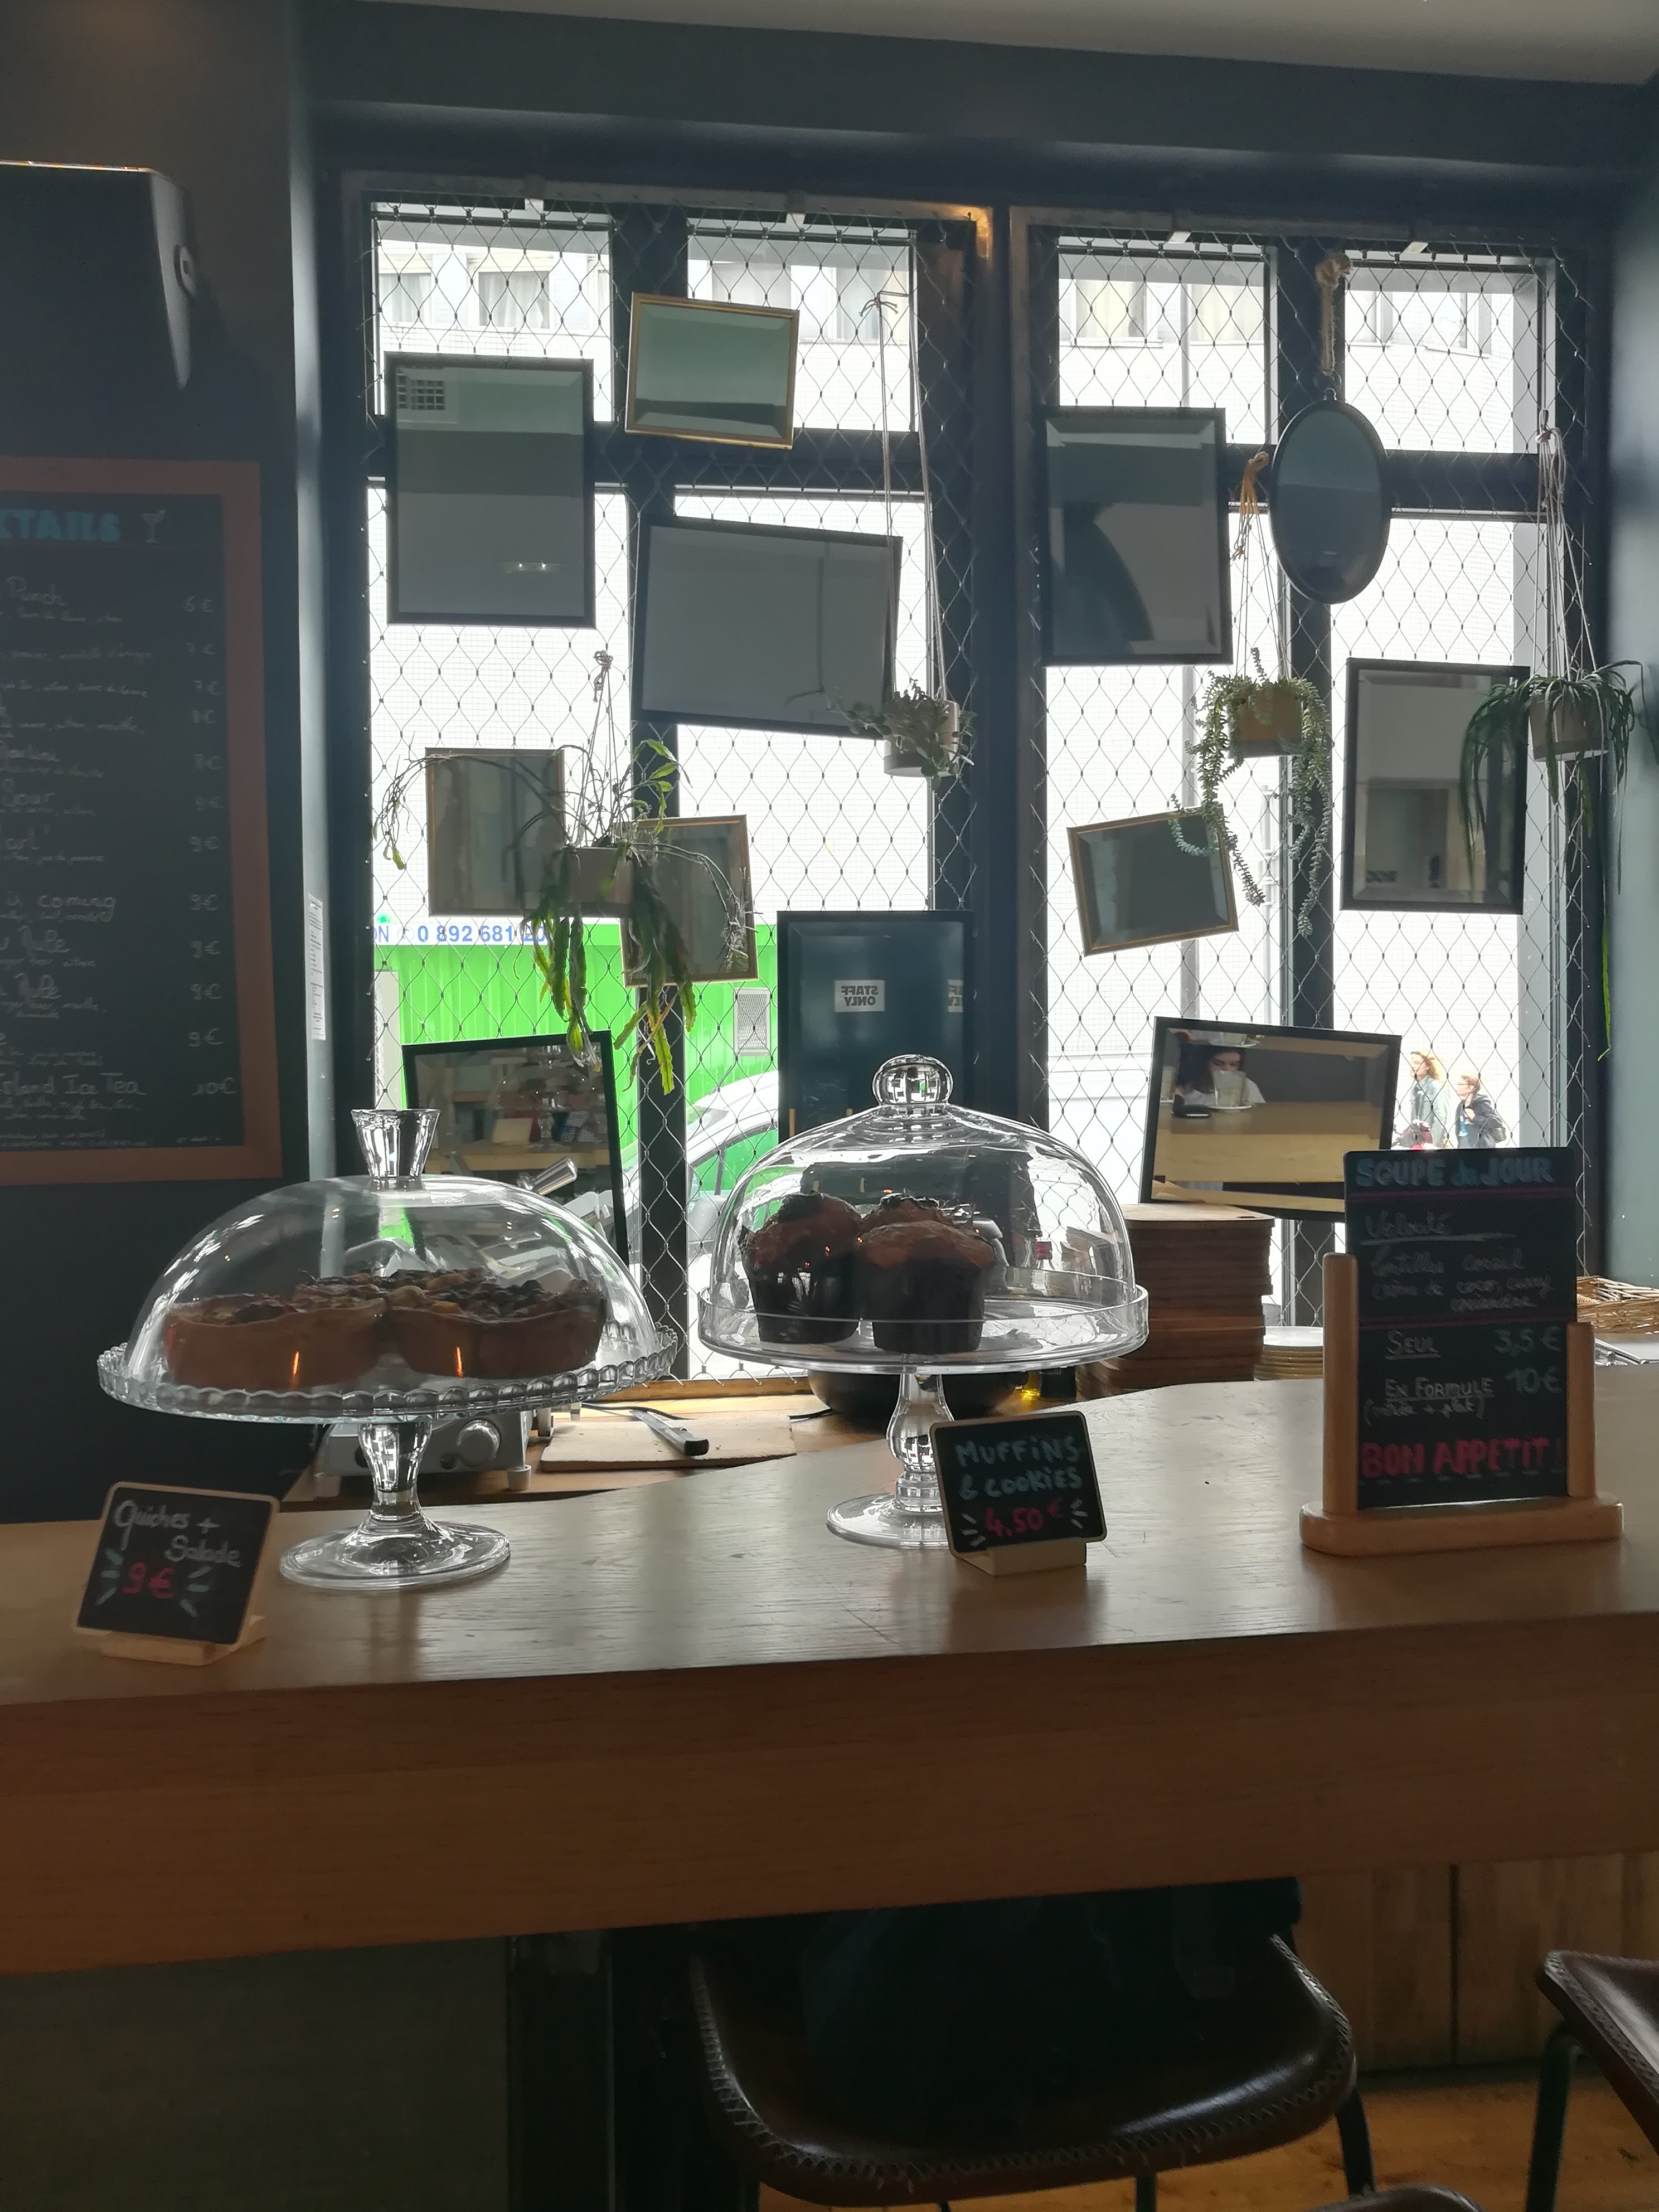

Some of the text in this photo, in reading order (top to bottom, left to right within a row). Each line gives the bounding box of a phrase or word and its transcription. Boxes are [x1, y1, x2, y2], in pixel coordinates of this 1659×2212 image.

[418, 925, 429, 942] 0
[436, 925, 473, 942] 892
[480, 925, 512, 942] 681
[188, 1027, 224, 1047] 9€
[99, 1072, 147, 1096] Tea
[191, 1076, 237, 1096] 10€
[1356, 1158, 1447, 1187] SOUPE
[1479, 1157, 1556, 1187] JOUR
[1361, 1442, 1425, 1478] BON
